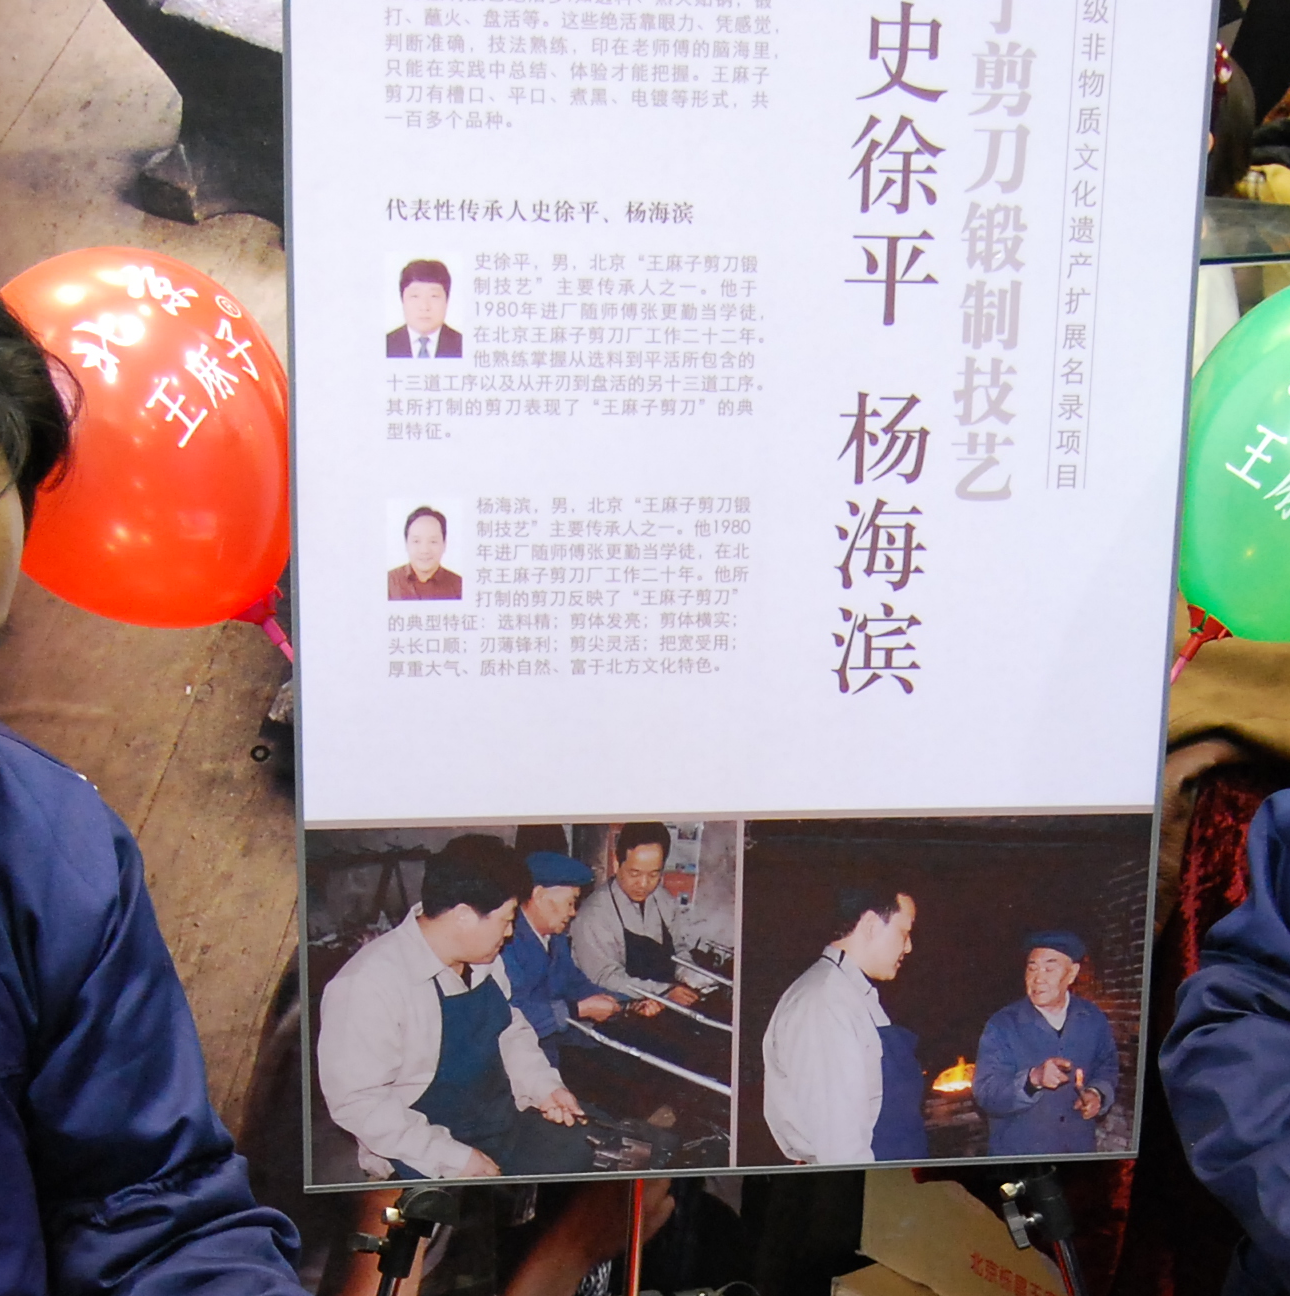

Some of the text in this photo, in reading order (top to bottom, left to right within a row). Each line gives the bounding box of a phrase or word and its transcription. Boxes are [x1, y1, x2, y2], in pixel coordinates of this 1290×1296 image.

[384, 110, 512, 130] 一百多个品种。
[385, 198, 694, 225] 代表性传承人史徐平、杨海滨
[1055, 0, 1109, 489] 级非物质文化遗产扩展名录项目
[830, 1, 948, 695] 史徐平 杨海滨
[387, 422, 452, 441] 型特征。
